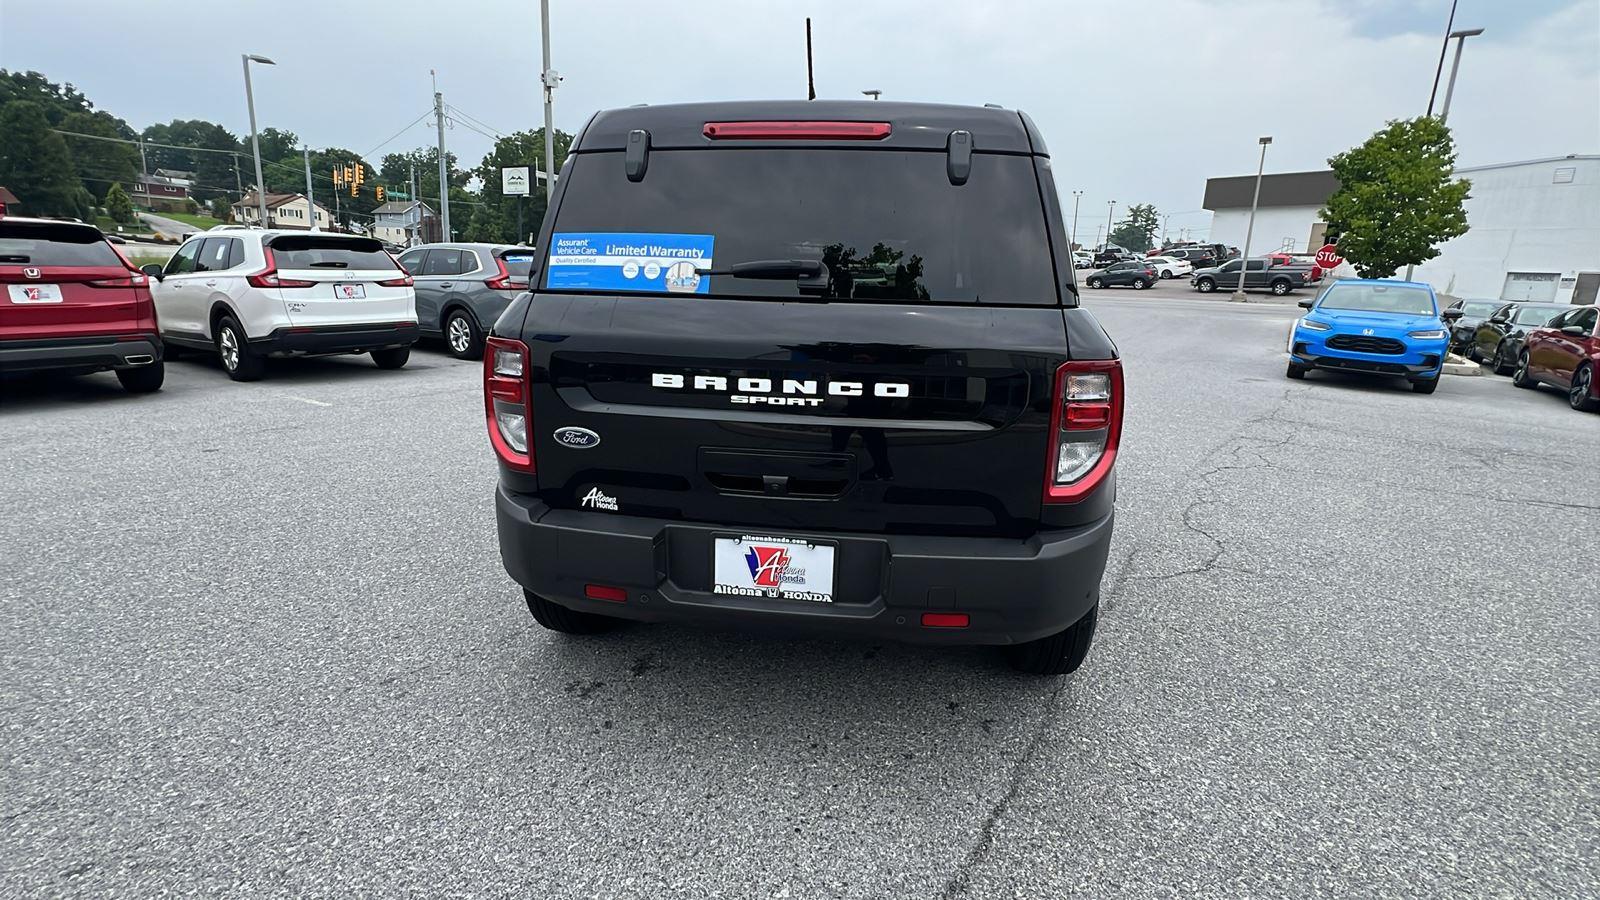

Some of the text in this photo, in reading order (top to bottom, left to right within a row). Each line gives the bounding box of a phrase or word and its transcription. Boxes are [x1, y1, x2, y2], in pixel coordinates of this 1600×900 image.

[557, 238, 589, 247] Assurant
[557, 247, 597, 255] Vehicle Care
[605, 245, 704, 259] Limited Warranty
[652, 373, 910, 398] BRONCO
[730, 395, 824, 407] SPORT
[562, 430, 589, 444] Ford
[596, 501, 619, 511] Honda
[741, 535, 807, 545] altoonahonda.com
[775, 573, 806, 584] Honda
[713, 584, 833, 602] Altoona HONDA
